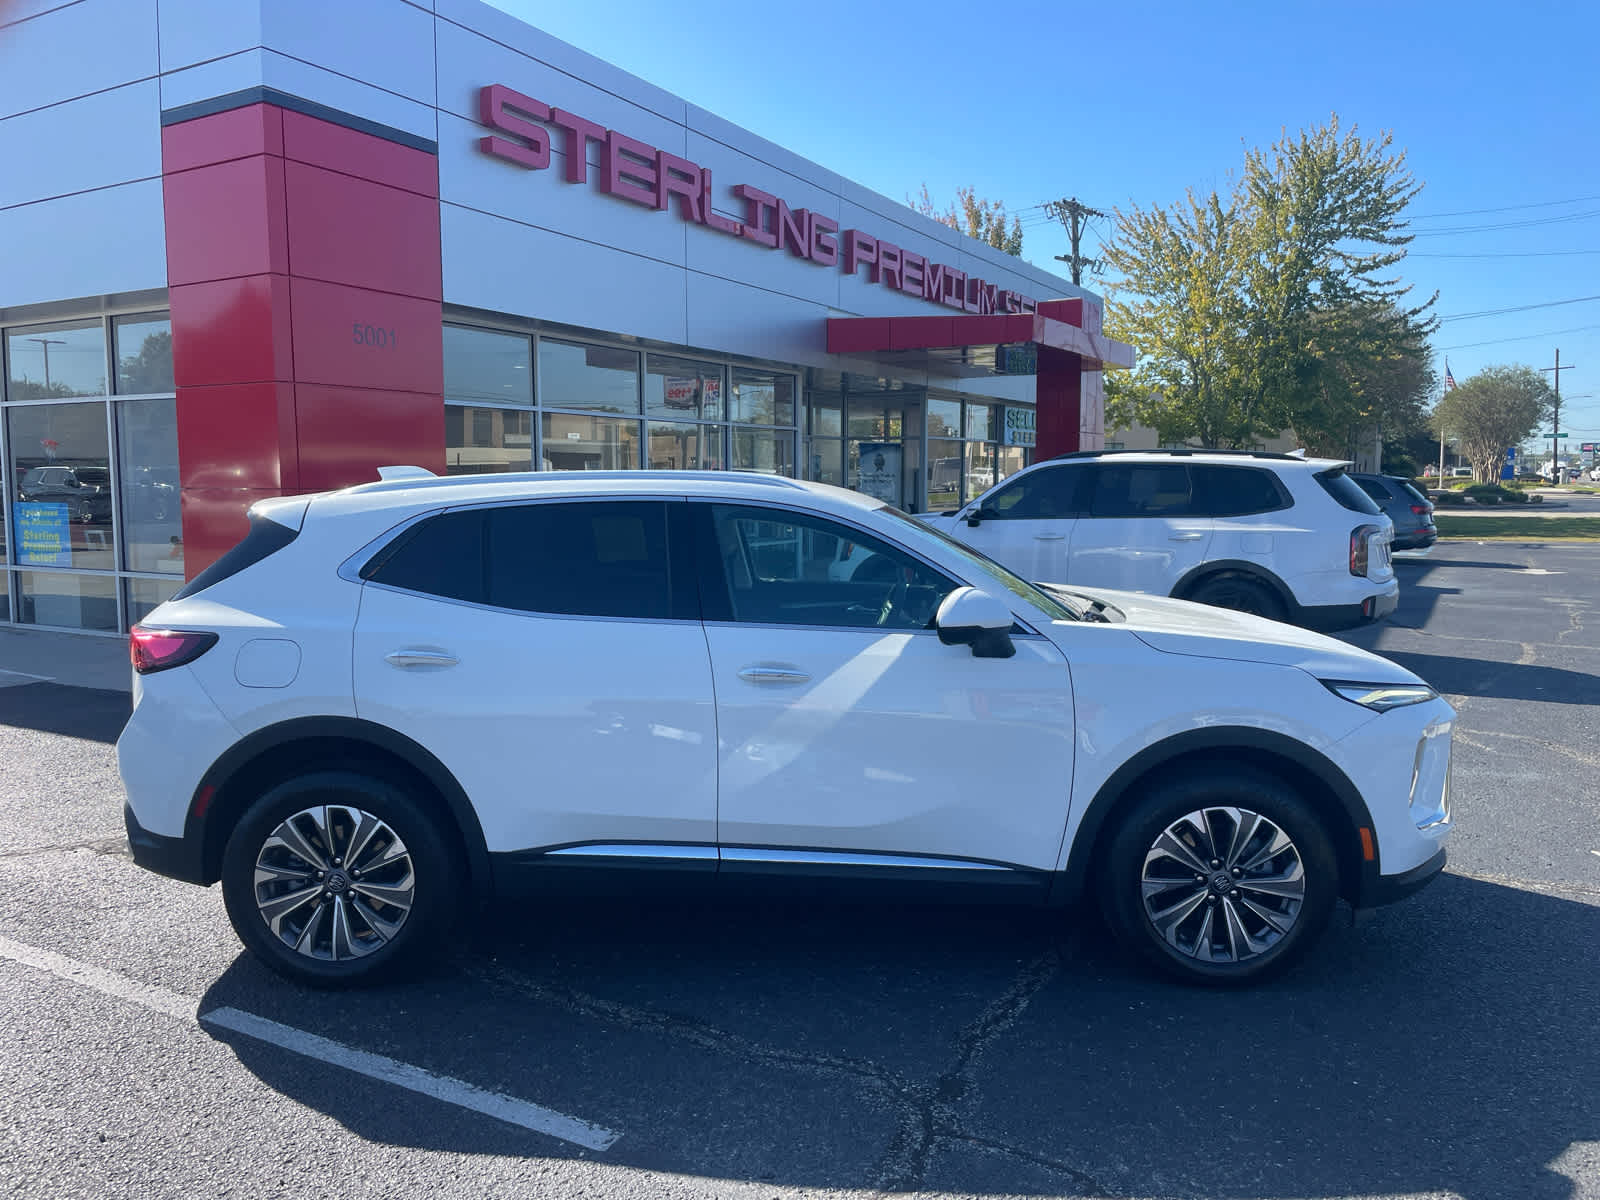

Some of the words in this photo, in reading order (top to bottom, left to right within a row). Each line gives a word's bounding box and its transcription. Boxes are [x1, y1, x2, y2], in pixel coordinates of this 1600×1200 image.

[479, 83, 839, 267] STERLING
[844, 229, 999, 315] PREMIUM
[1000, 289, 1038, 315] SE
[352, 323, 397, 350] 5001
